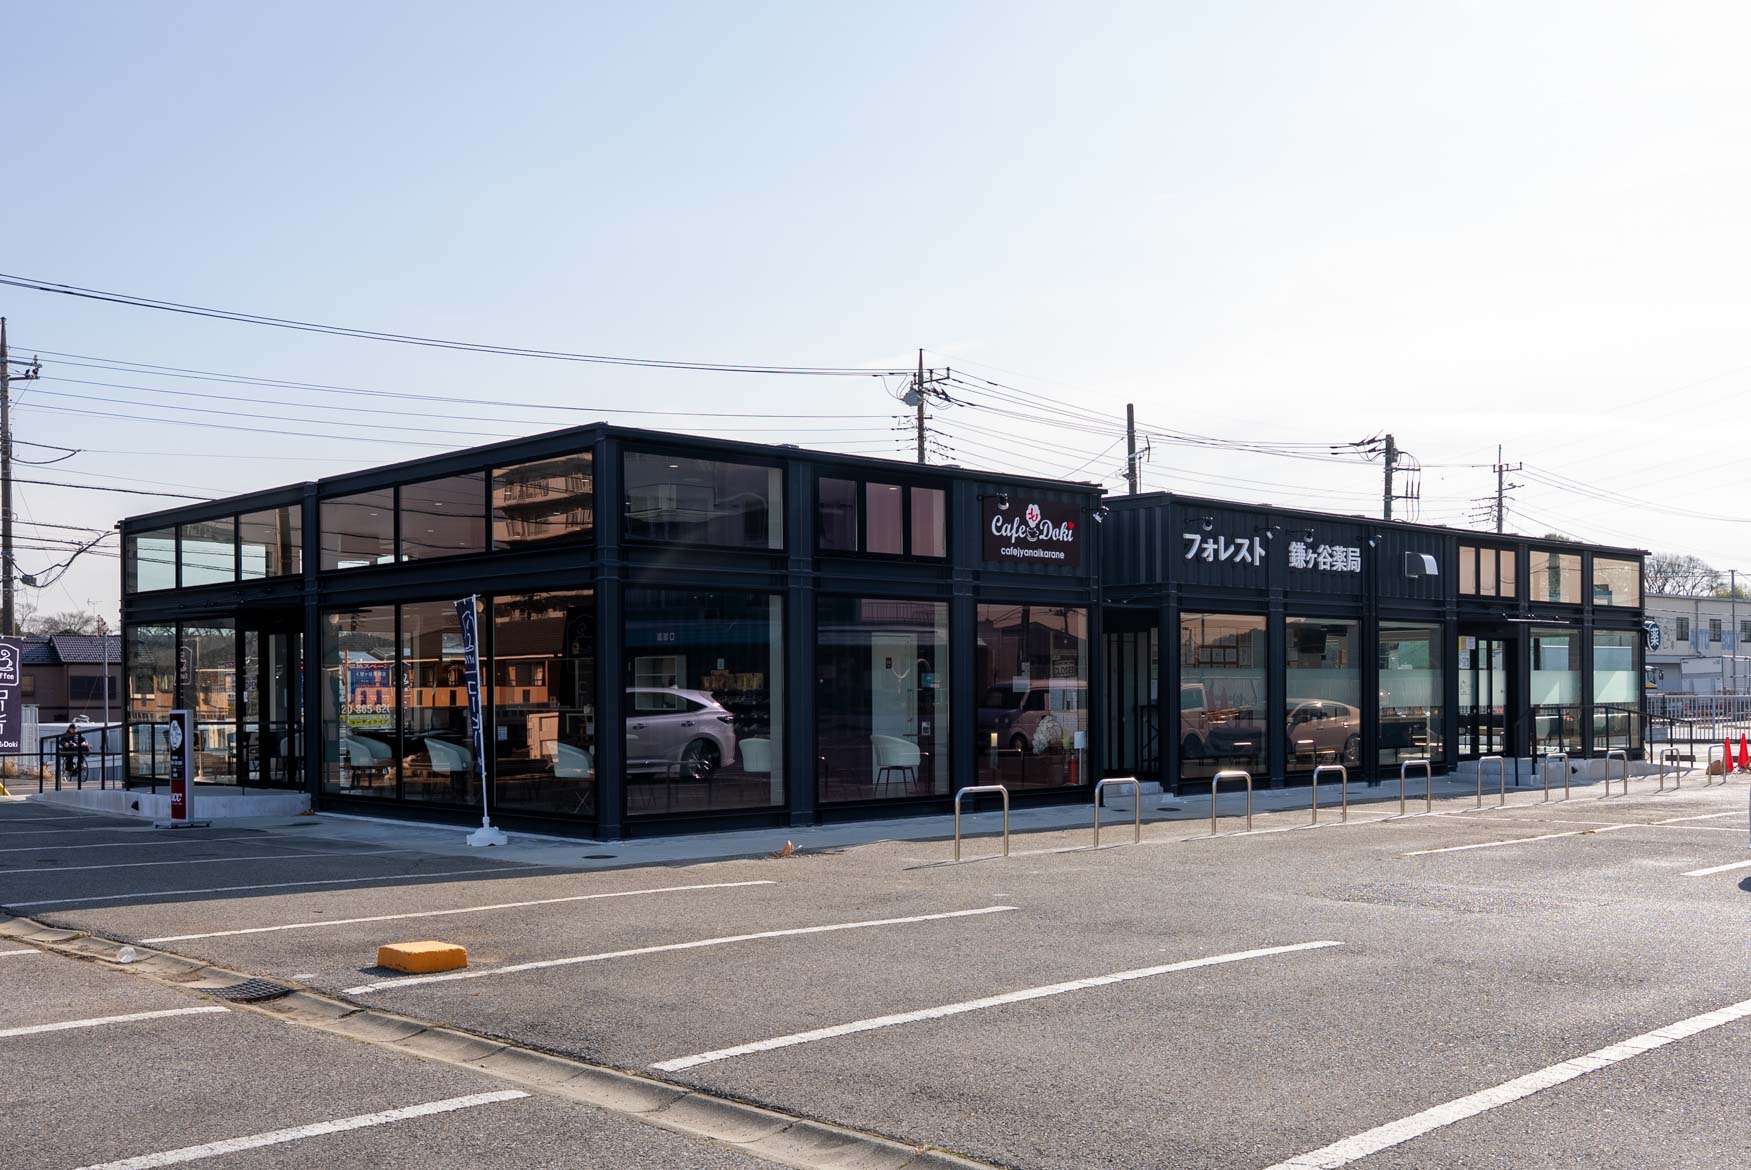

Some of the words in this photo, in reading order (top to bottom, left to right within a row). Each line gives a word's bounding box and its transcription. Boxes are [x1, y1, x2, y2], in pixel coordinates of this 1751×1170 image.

[991, 515, 1027, 543] Cafe
[1039, 519, 1075, 543] Doki
[1000, 546, 1065, 559] cafejyanaikarane
[1183, 533, 1265, 566] フォレスト
[1288, 541, 1361, 572] 鎌ヶ谷薬局
[1650, 627, 1659, 647] 薬
[0, 672, 15, 680] ffee
